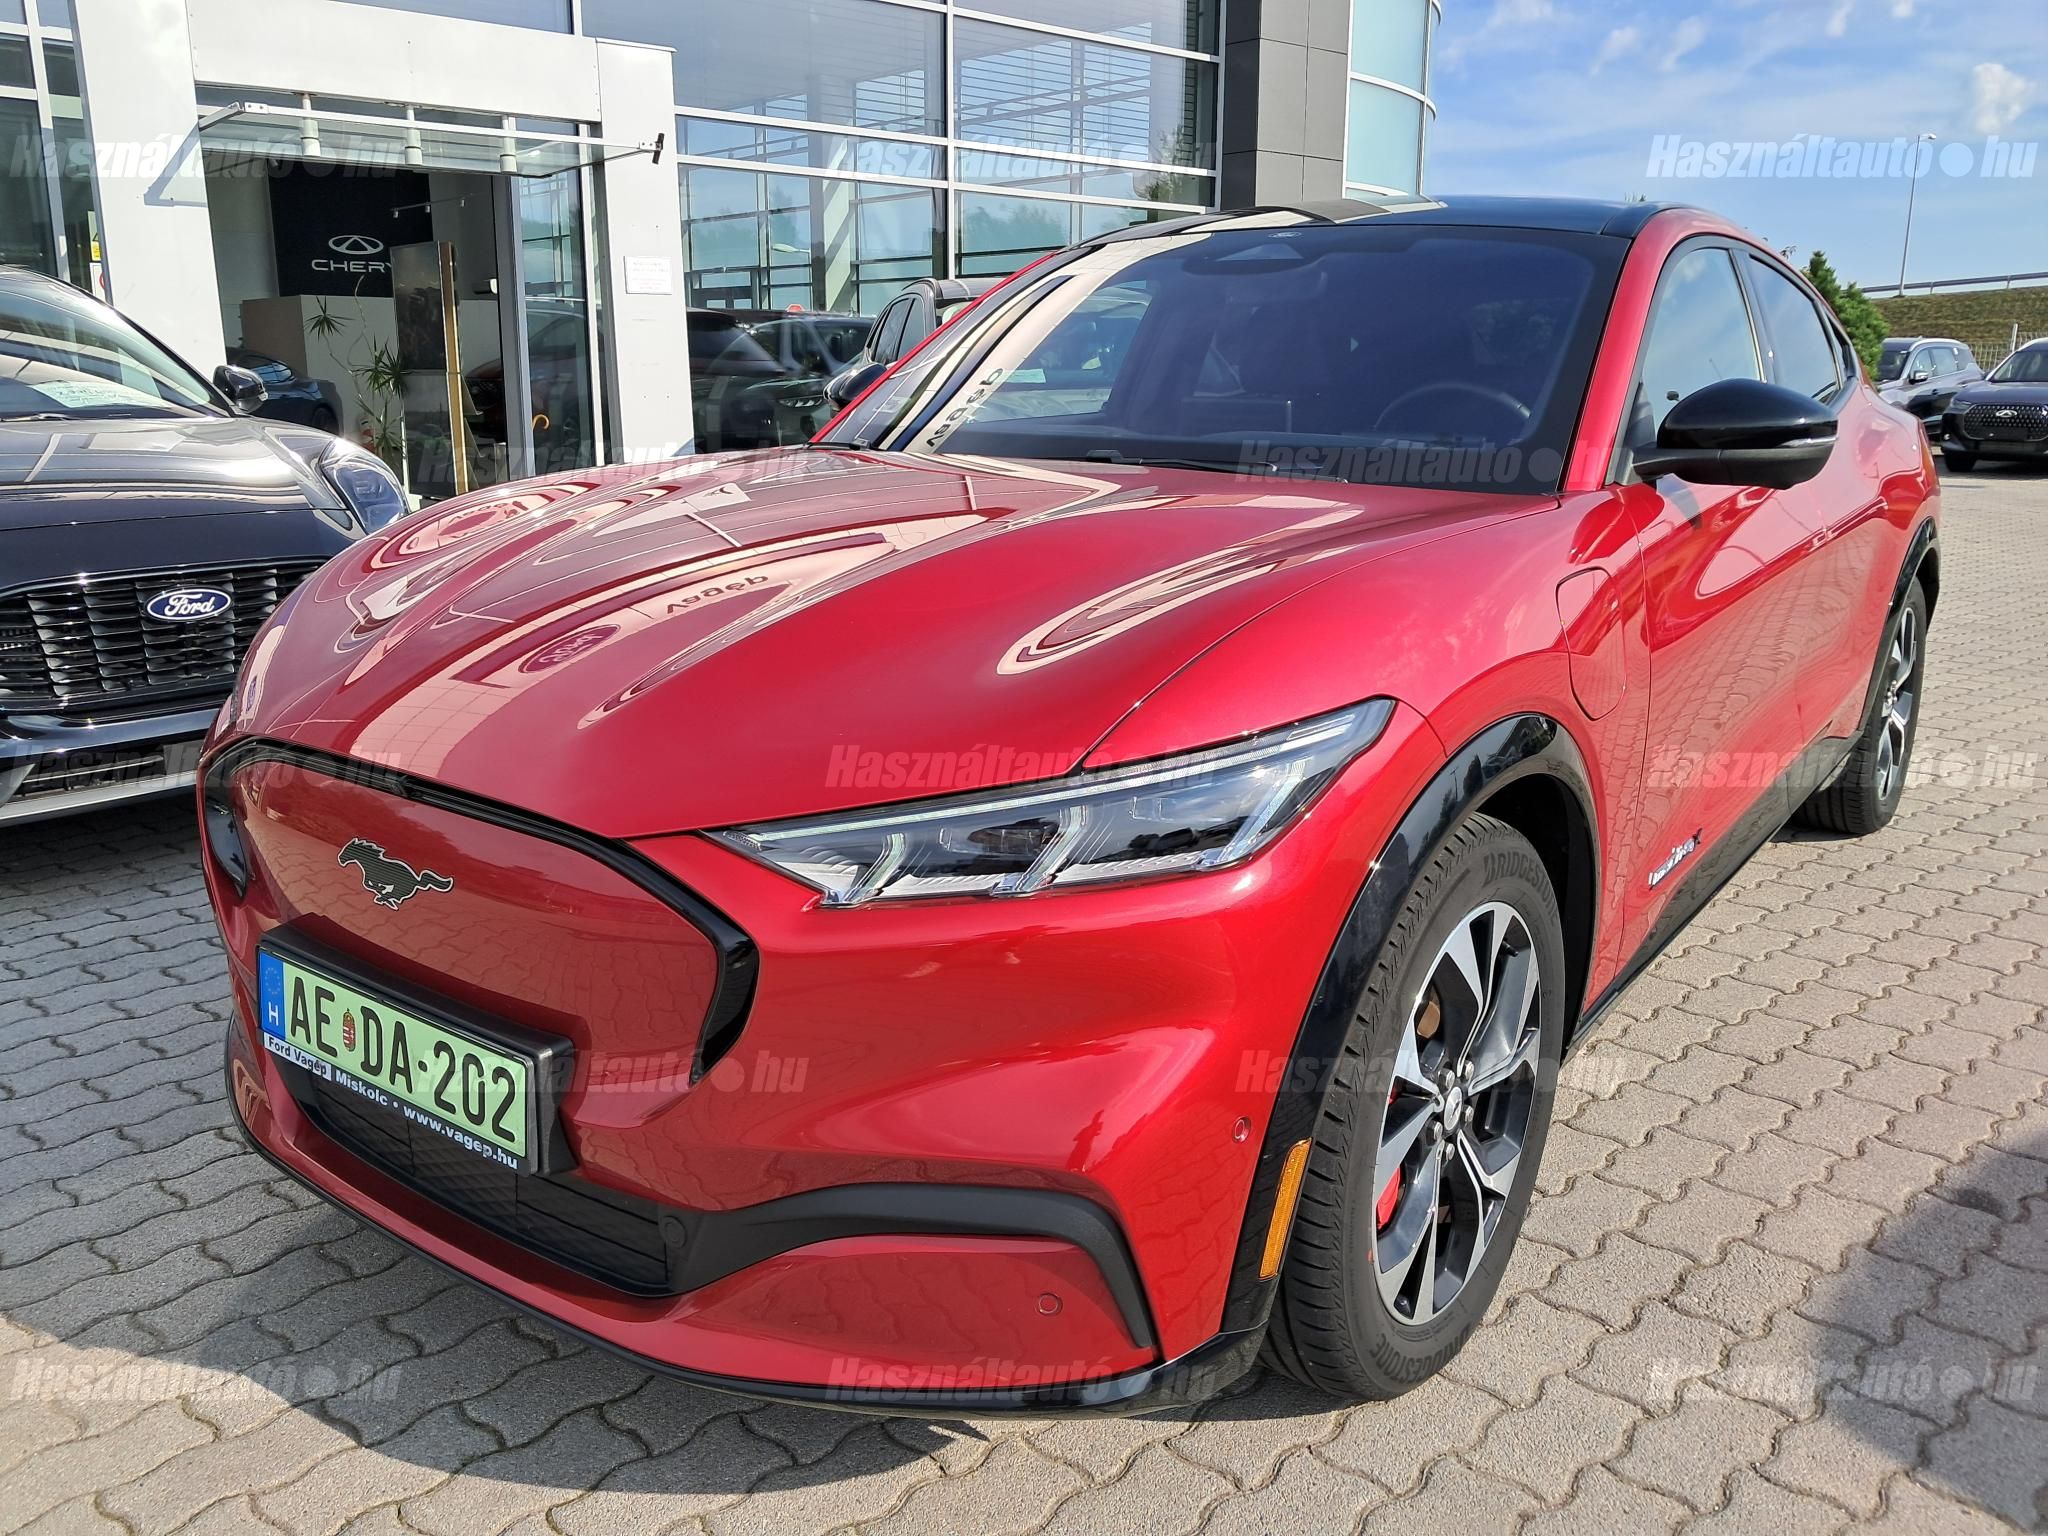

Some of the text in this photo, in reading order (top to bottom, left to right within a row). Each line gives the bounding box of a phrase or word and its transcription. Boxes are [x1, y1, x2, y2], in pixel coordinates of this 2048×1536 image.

[164, 593, 216, 616] Ford
[268, 1001, 279, 1026] H
[290, 976, 338, 1058] AE
[268, 1036, 518, 1169] Ford Vagép Miskolc www.vagep.hu
